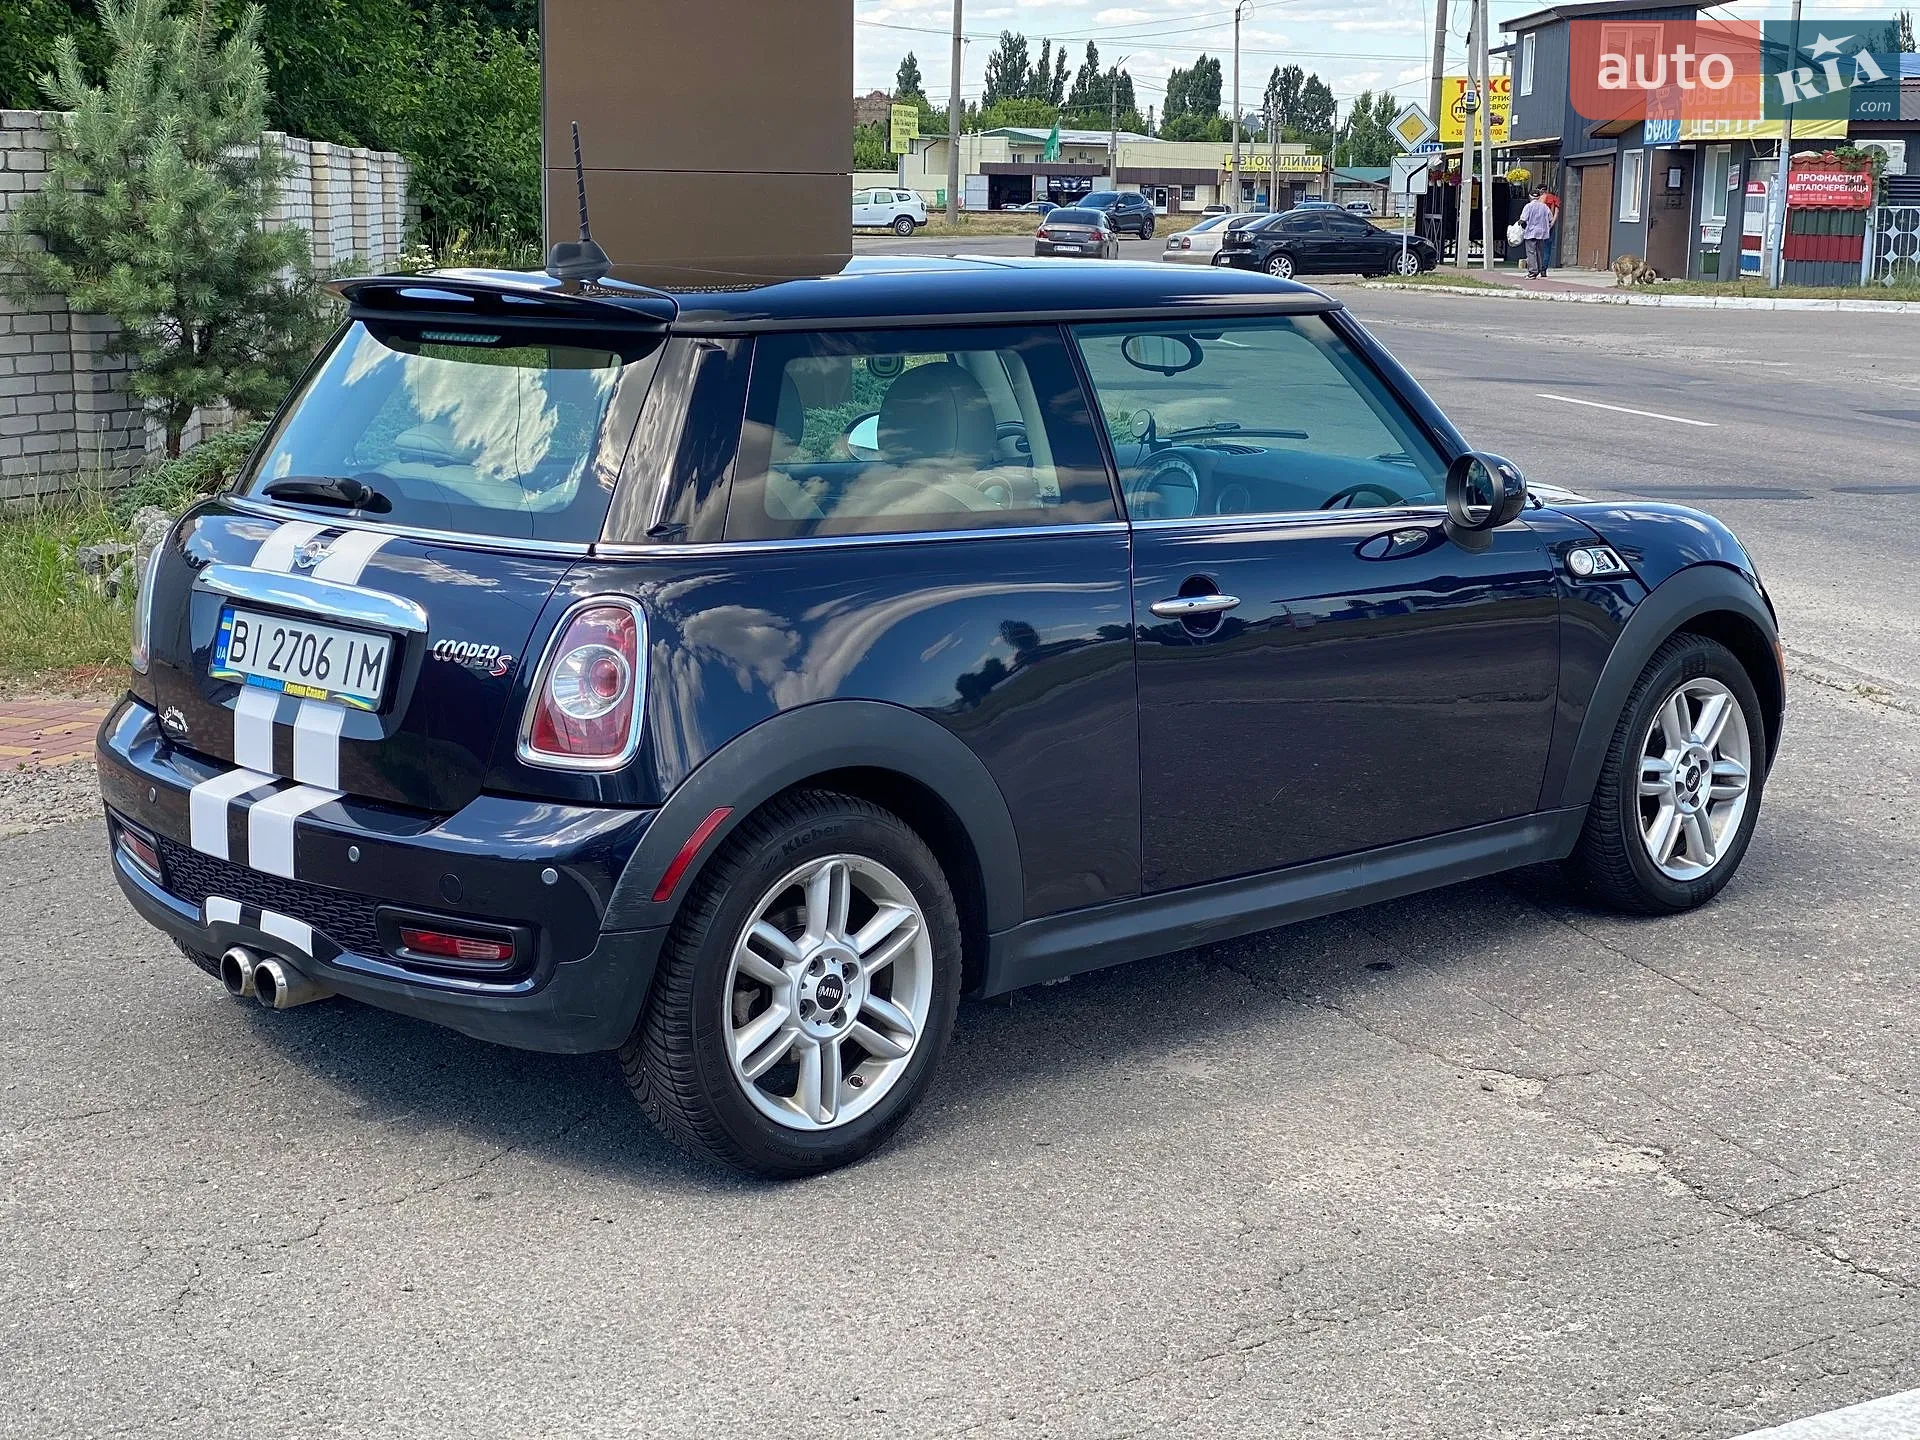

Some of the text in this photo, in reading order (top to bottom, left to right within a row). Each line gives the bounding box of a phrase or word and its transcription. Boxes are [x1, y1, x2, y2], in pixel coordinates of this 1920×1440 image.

[1691, 110, 1765, 135] ЦЕНТР
[1797, 173, 1863, 183] ПРОФНАСТИЛ
[1788, 183, 1869, 194] МЕТАЛОЧЕРЕПИЦЯ
[216, 646, 226, 661] UA
[229, 620, 385, 692] BI 2706 IM
[433, 639, 513, 677] COOPER S
[818, 985, 841, 999] MINI
